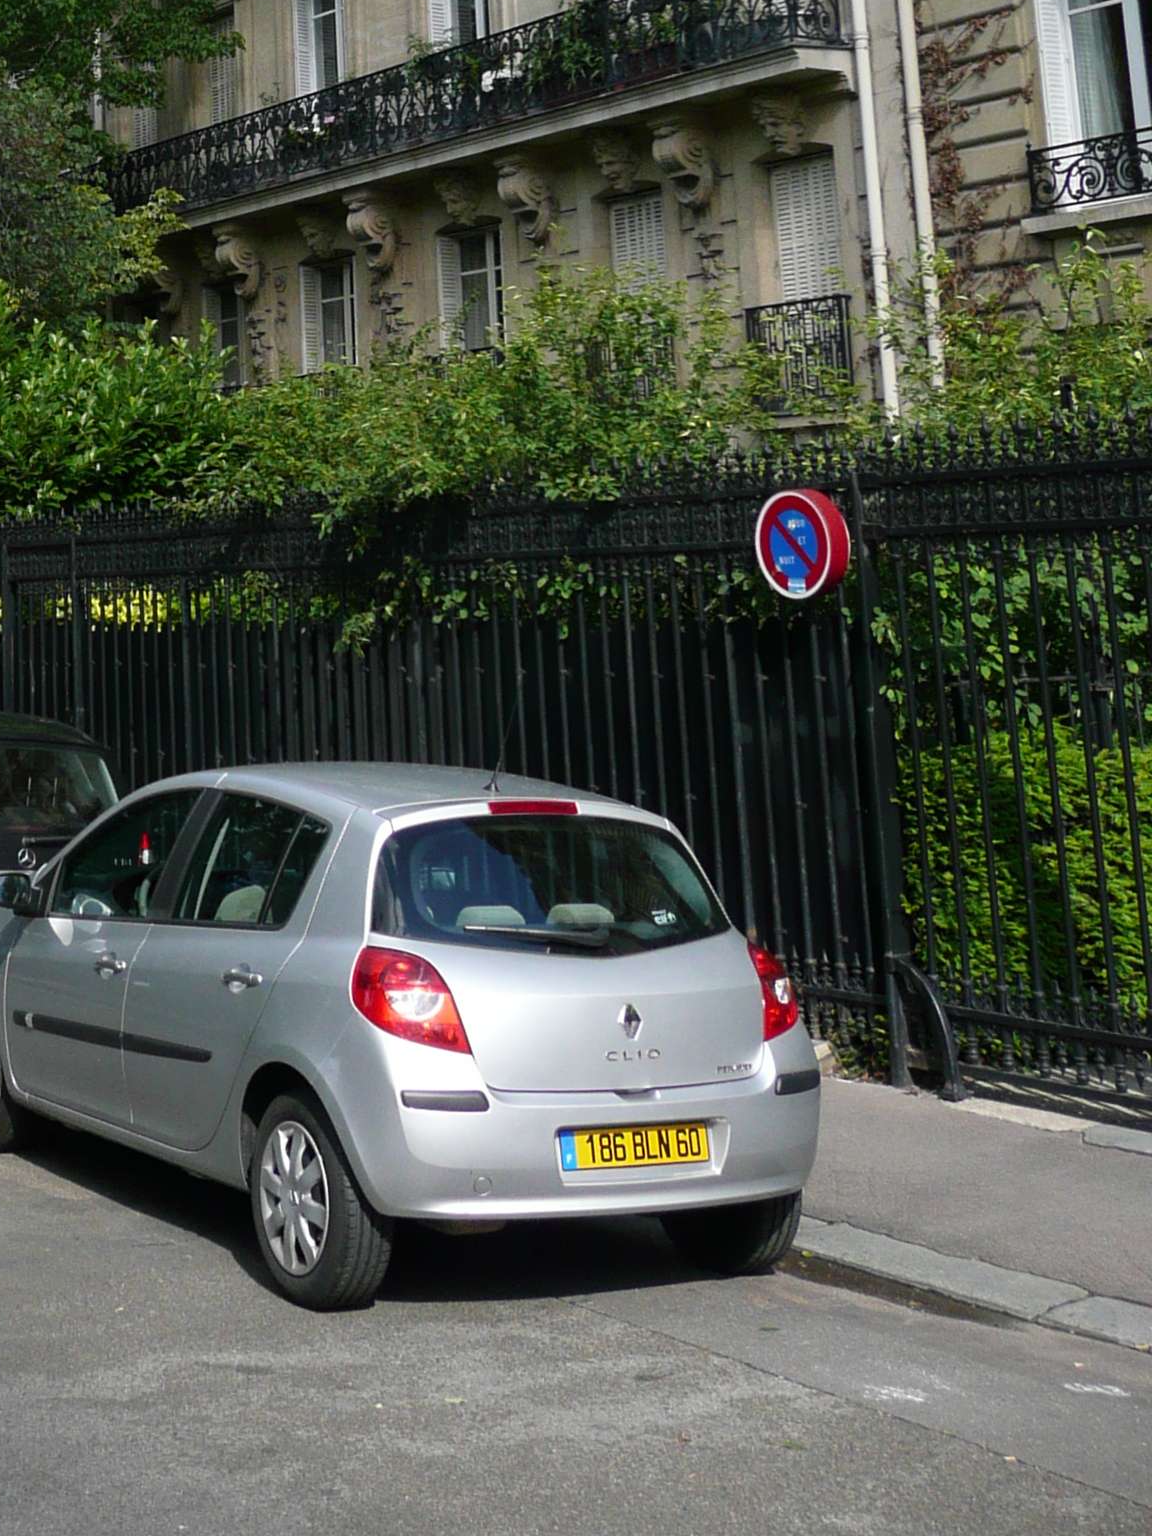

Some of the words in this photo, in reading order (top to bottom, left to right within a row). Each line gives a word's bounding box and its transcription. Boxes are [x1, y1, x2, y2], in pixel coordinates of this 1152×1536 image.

[797, 536, 806, 546] ET
[779, 556, 795, 566] NUIT
[606, 1049, 661, 1062] CLIO
[586, 1130, 626, 1164] 186
[632, 1128, 671, 1161] BLN
[677, 1128, 701, 1158] 60
